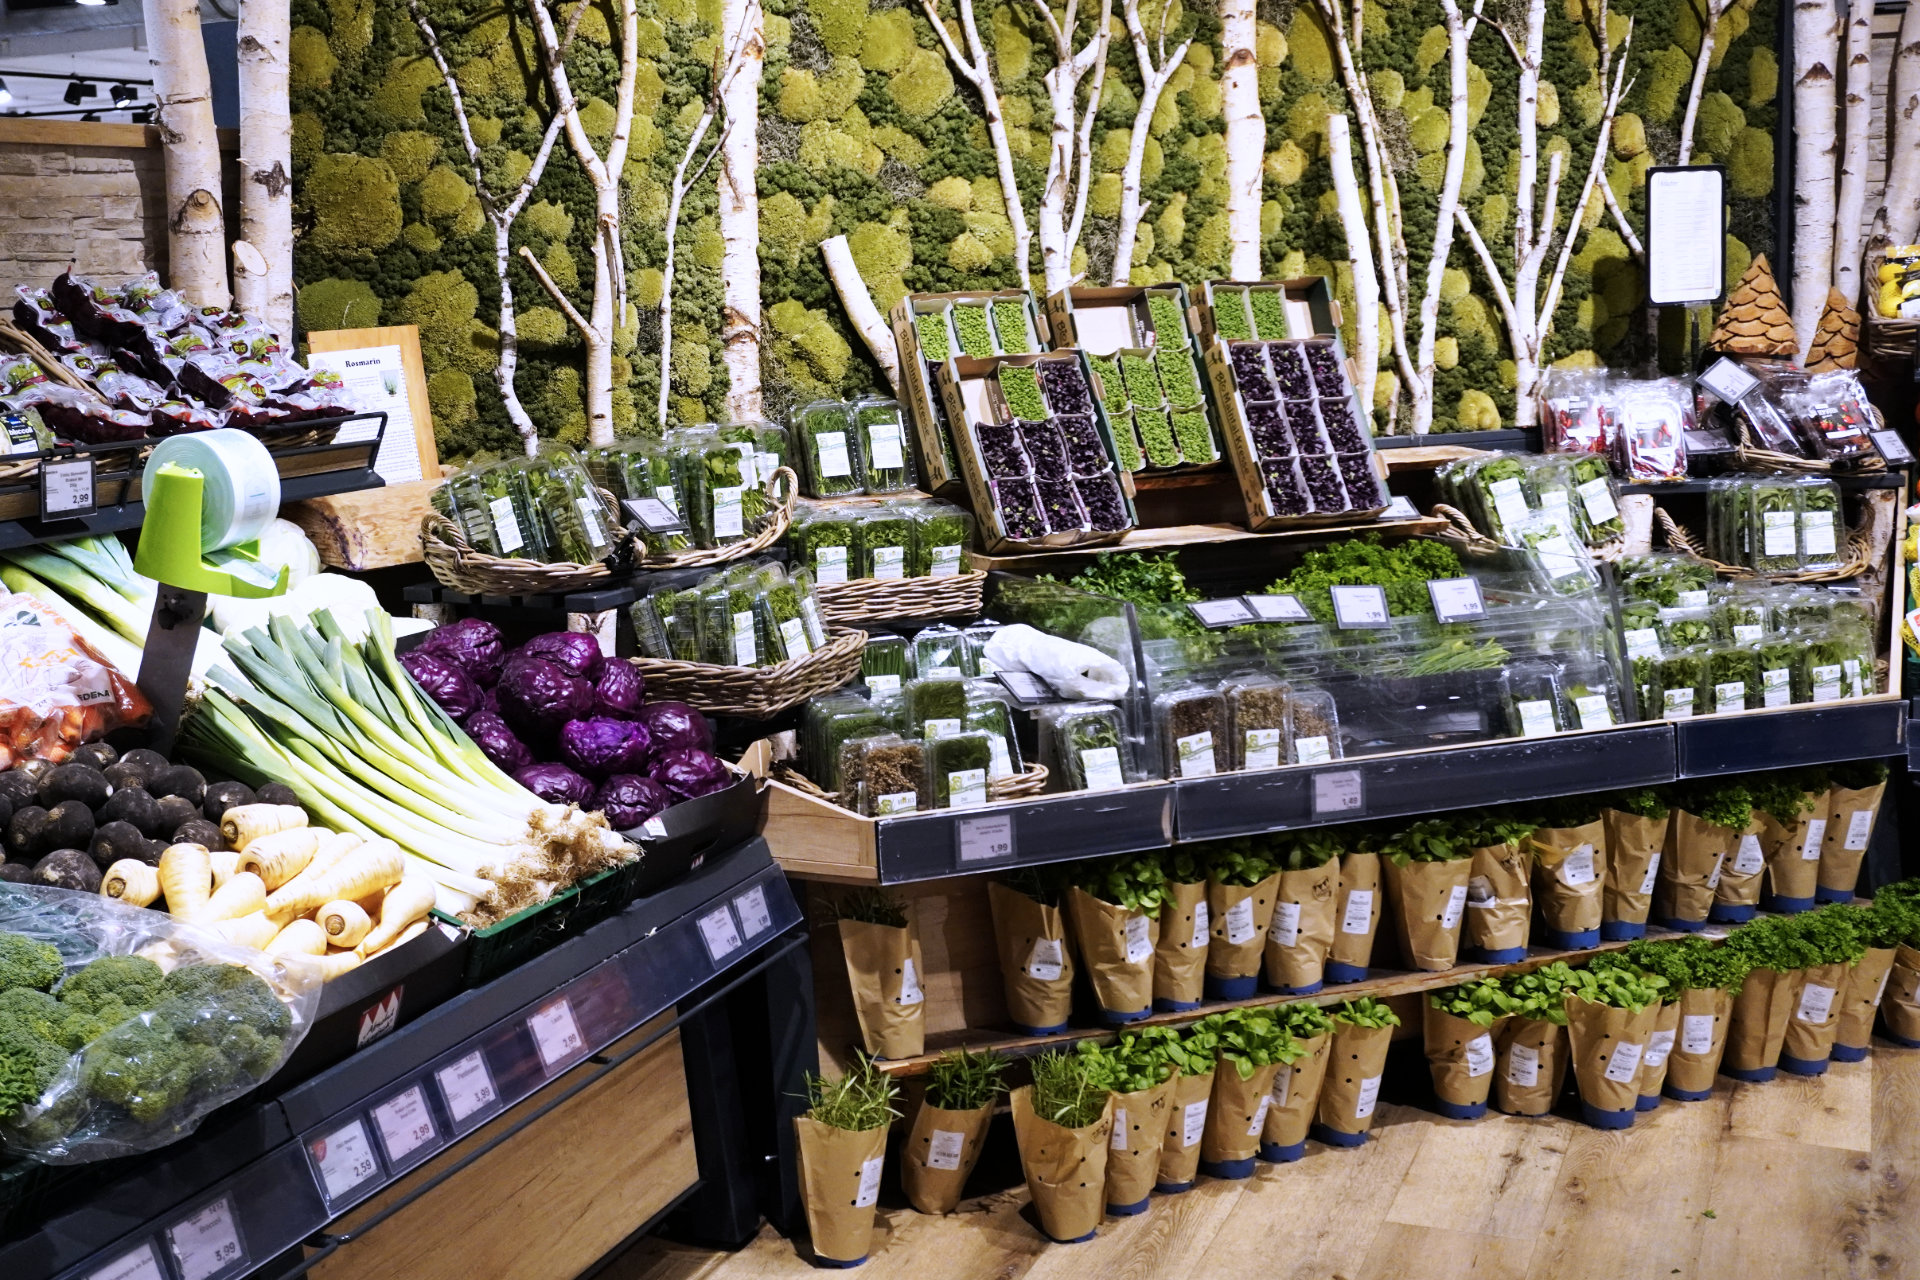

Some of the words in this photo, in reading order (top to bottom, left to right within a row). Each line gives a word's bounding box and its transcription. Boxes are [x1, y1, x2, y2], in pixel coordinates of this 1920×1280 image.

[899, 327, 914, 349] Bio
[1057, 320, 1069, 341] Bio
[345, 358, 381, 368] Rosmarin
[1214, 371, 1229, 391] Bio
[903, 349, 931, 443] Maintal-Kresse
[947, 392, 960, 414] Bio
[1221, 390, 1252, 477] Maintal-Kresse
[950, 414, 982, 501] Maintal-Kresse
[72, 493, 89, 504] 2,99
[1463, 602, 1479, 611] 1,99
[1342, 797, 1358, 806] 1,49
[990, 843, 1008, 854] 1,99
[413, 1123, 430, 1140] 2,99
[353, 1159, 373, 1177] 2,59
[215, 1241, 237, 1262] 3,99
